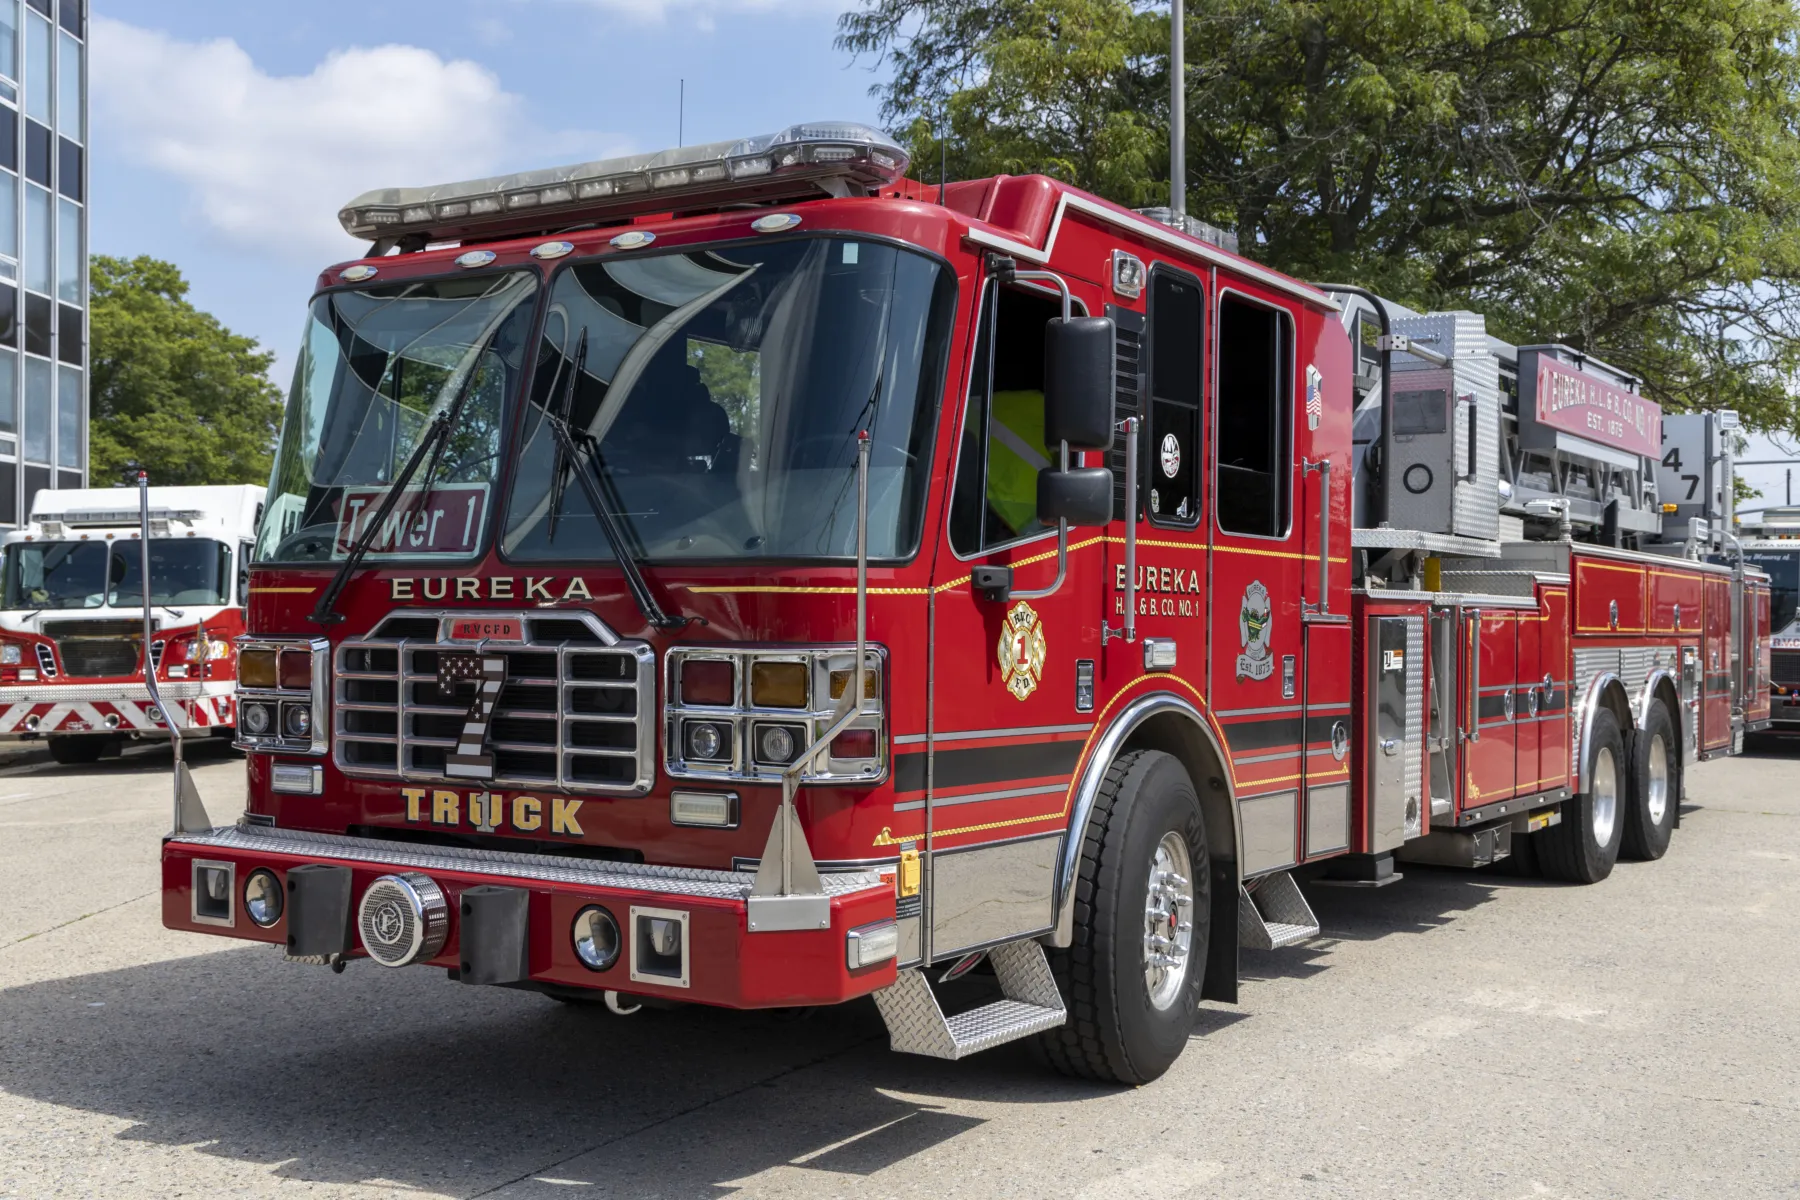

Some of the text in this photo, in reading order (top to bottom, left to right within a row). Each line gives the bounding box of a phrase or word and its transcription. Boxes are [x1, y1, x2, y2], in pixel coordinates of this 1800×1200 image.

[1551, 370, 1586, 412] EUREKA
[1606, 391, 1613, 411] &
[1587, 411, 1623, 438] EST. 1875
[462, 495, 477, 547] 1
[389, 577, 594, 600] EUREKA
[1139, 597, 1147, 616] &
[1150, 598, 1159, 616] B.
[1161, 598, 1176, 616] CO.
[1178, 599, 1193, 617] NO.
[1195, 600, 1199, 618] 1
[463, 622, 512, 635] RVCFD
[1016, 635, 1029, 665] 1
[1239, 657, 1271, 676] Est. 1875
[437, 652, 509, 781] 7
[401, 787, 585, 836] TRUCK
[475, 790, 496, 833] 1
